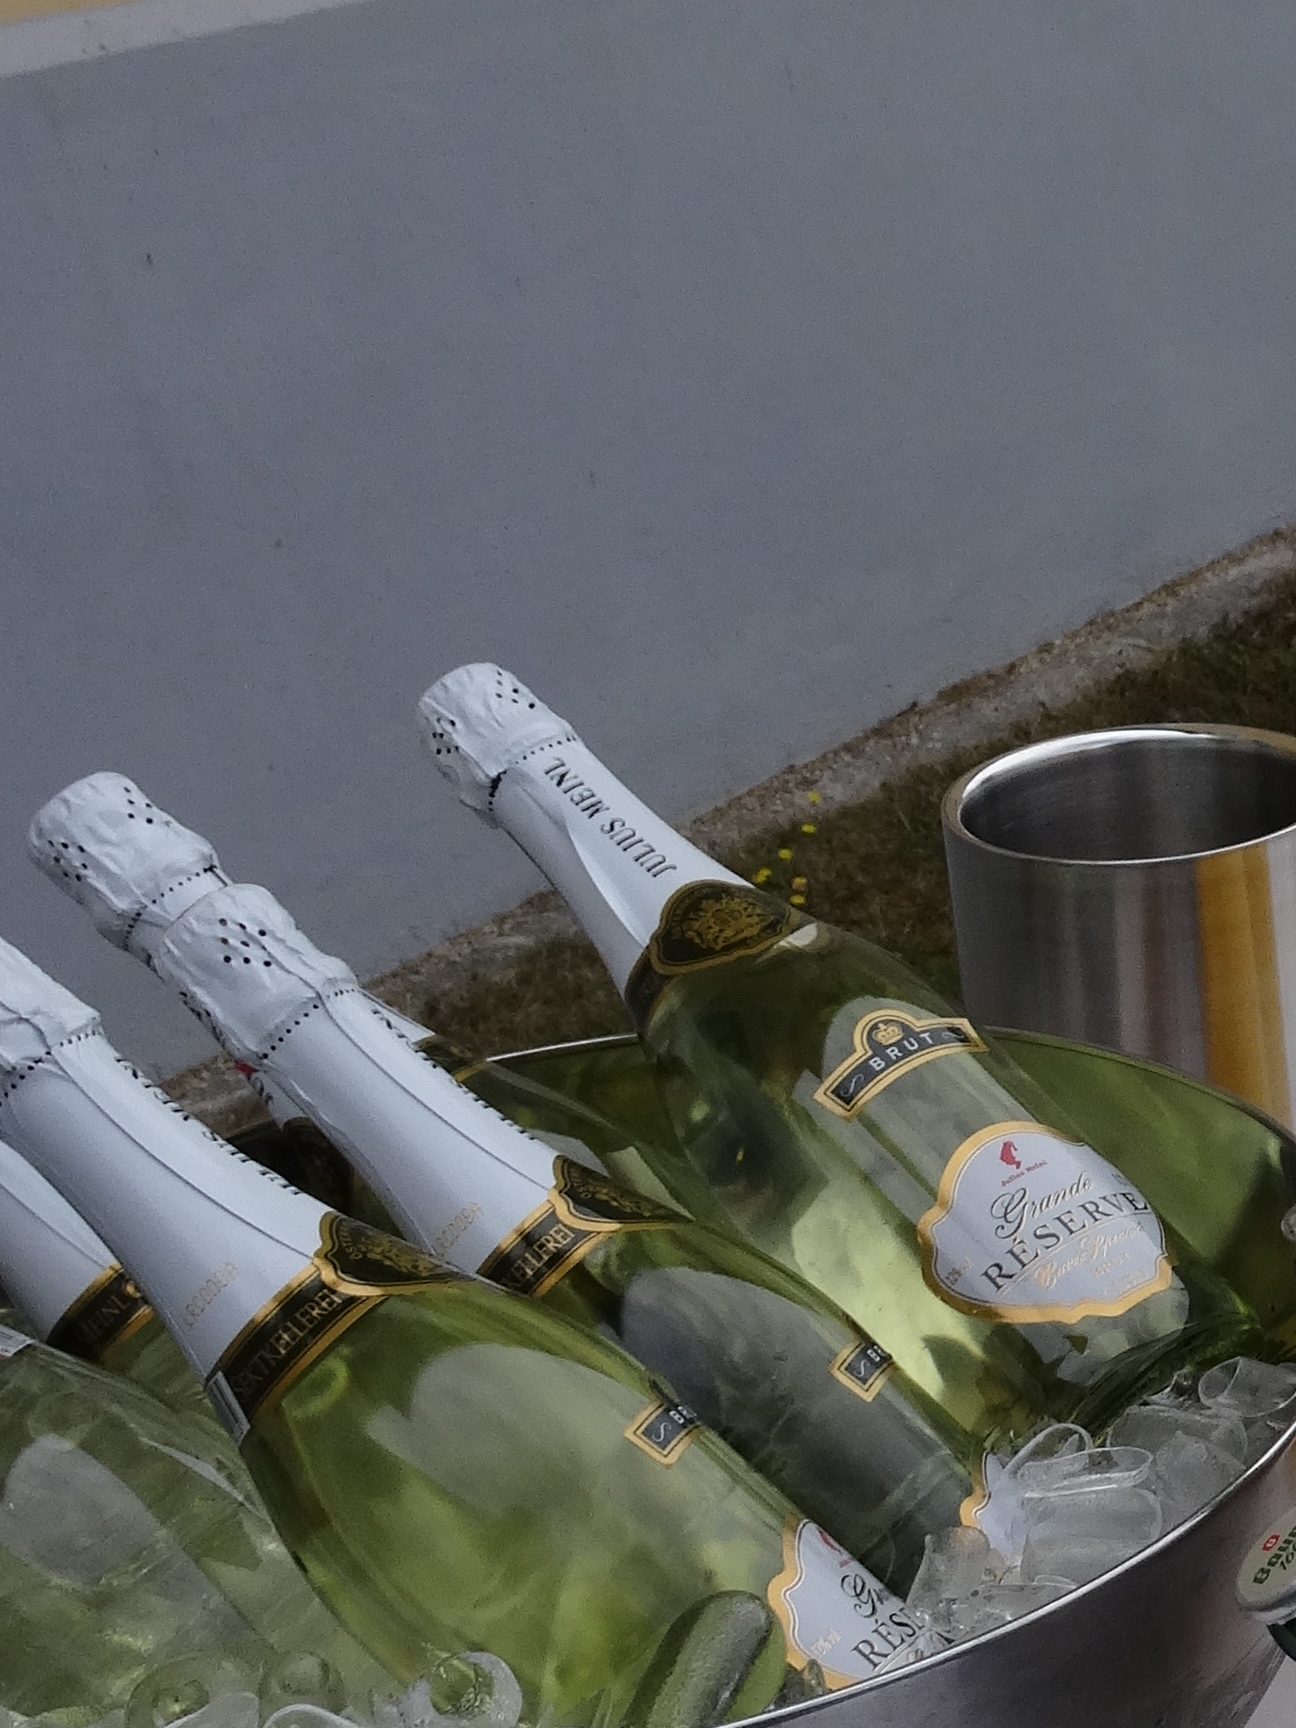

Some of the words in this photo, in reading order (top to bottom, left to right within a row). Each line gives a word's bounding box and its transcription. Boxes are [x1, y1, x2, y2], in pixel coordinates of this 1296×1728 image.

[545, 758, 610, 819] MEINL
[601, 817, 677, 878] JULIUS
[869, 1031, 934, 1073] BRUT
[990, 1171, 1093, 1239] Grande
[981, 1192, 1149, 1292] RÉSERVE
